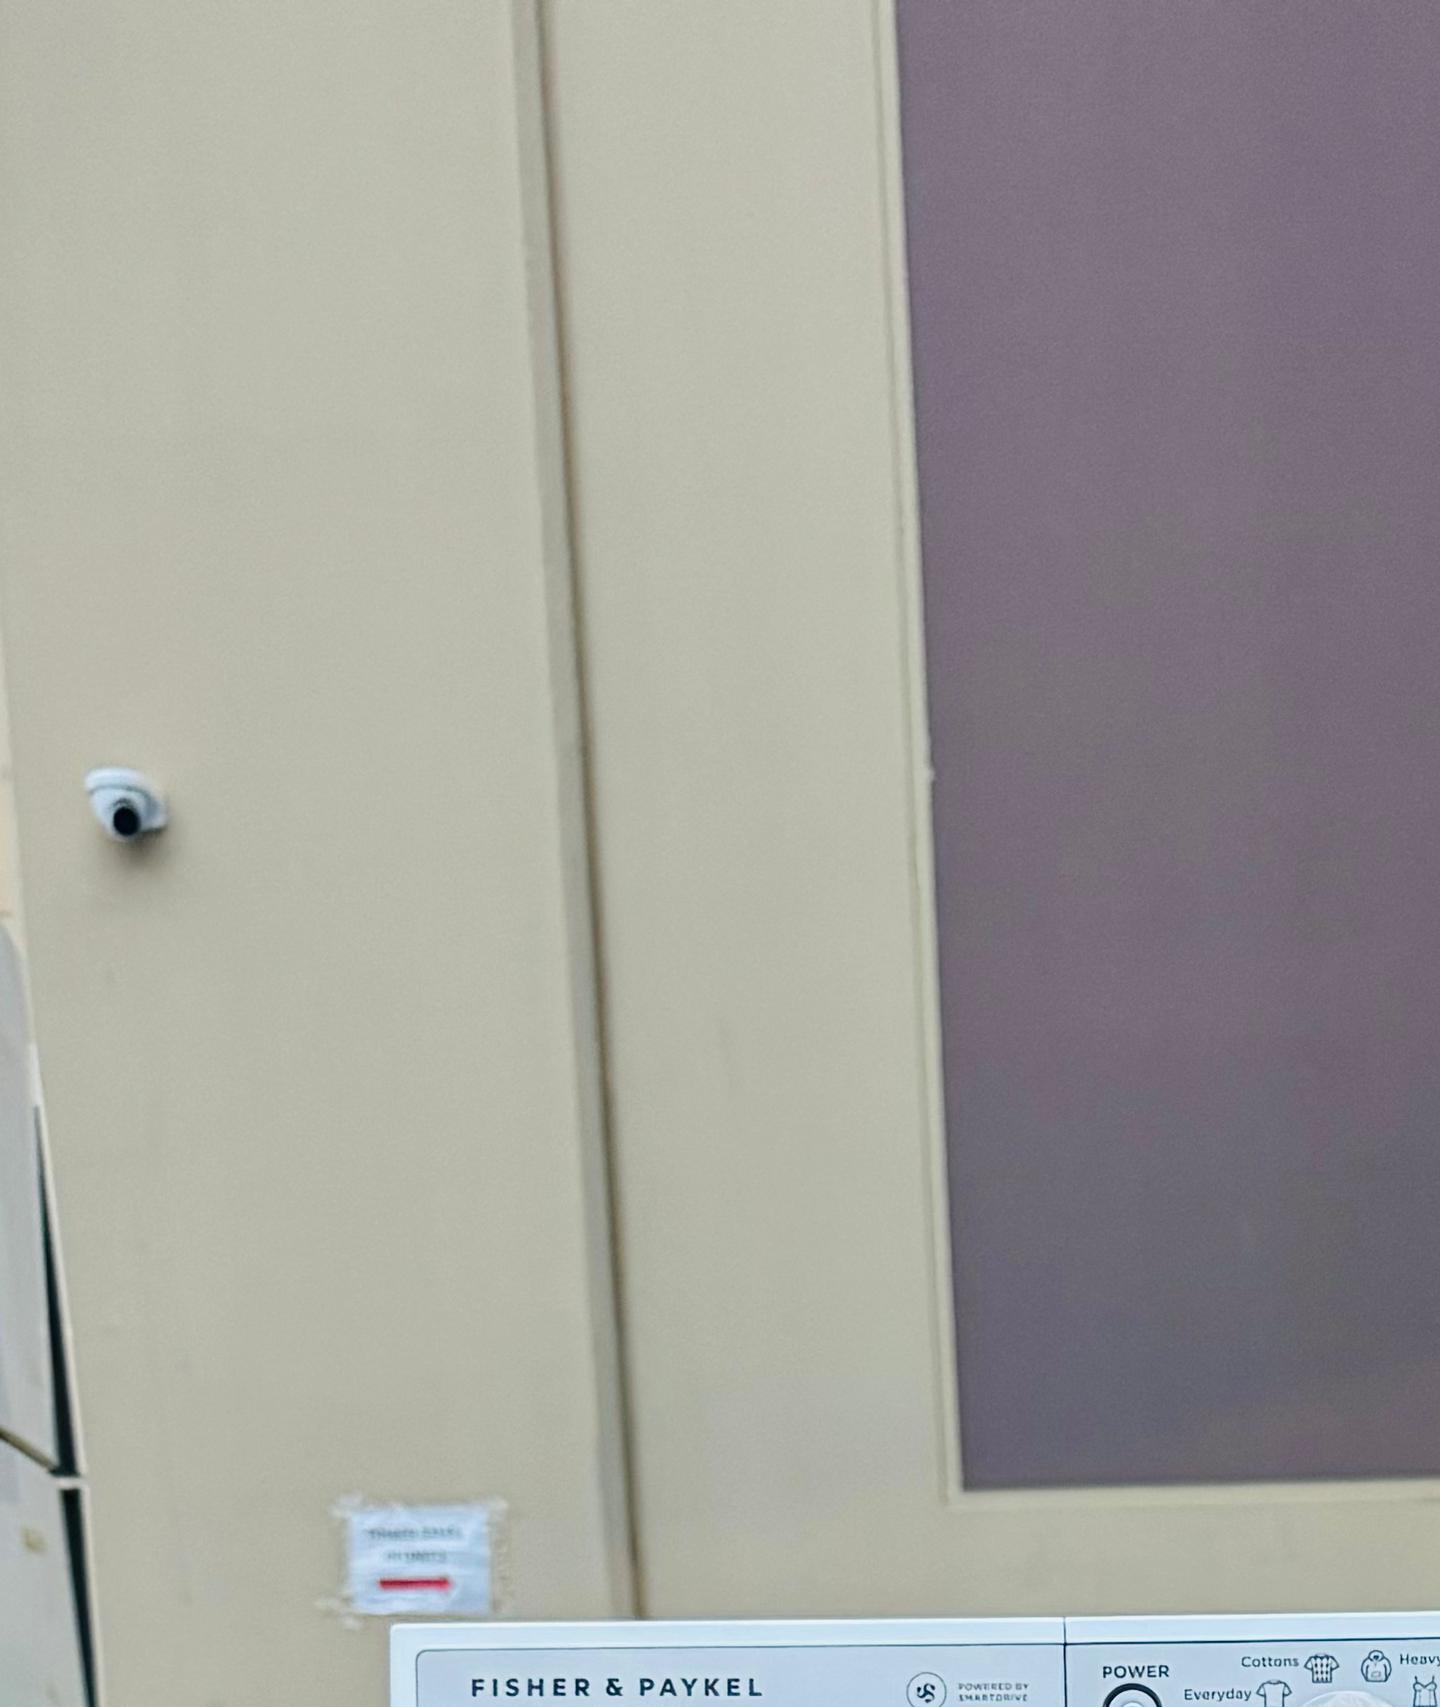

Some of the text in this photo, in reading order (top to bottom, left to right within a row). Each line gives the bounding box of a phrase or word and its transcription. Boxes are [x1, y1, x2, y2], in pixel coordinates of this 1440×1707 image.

[1241, 1656, 1299, 1669] Cottons
[1102, 1665, 1170, 1679] POWER
[472, 1678, 763, 1698] FISHER & PAYKEL
[958, 1683, 1029, 1691] POWERED BY
[1184, 1688, 1252, 1702] Everyday
